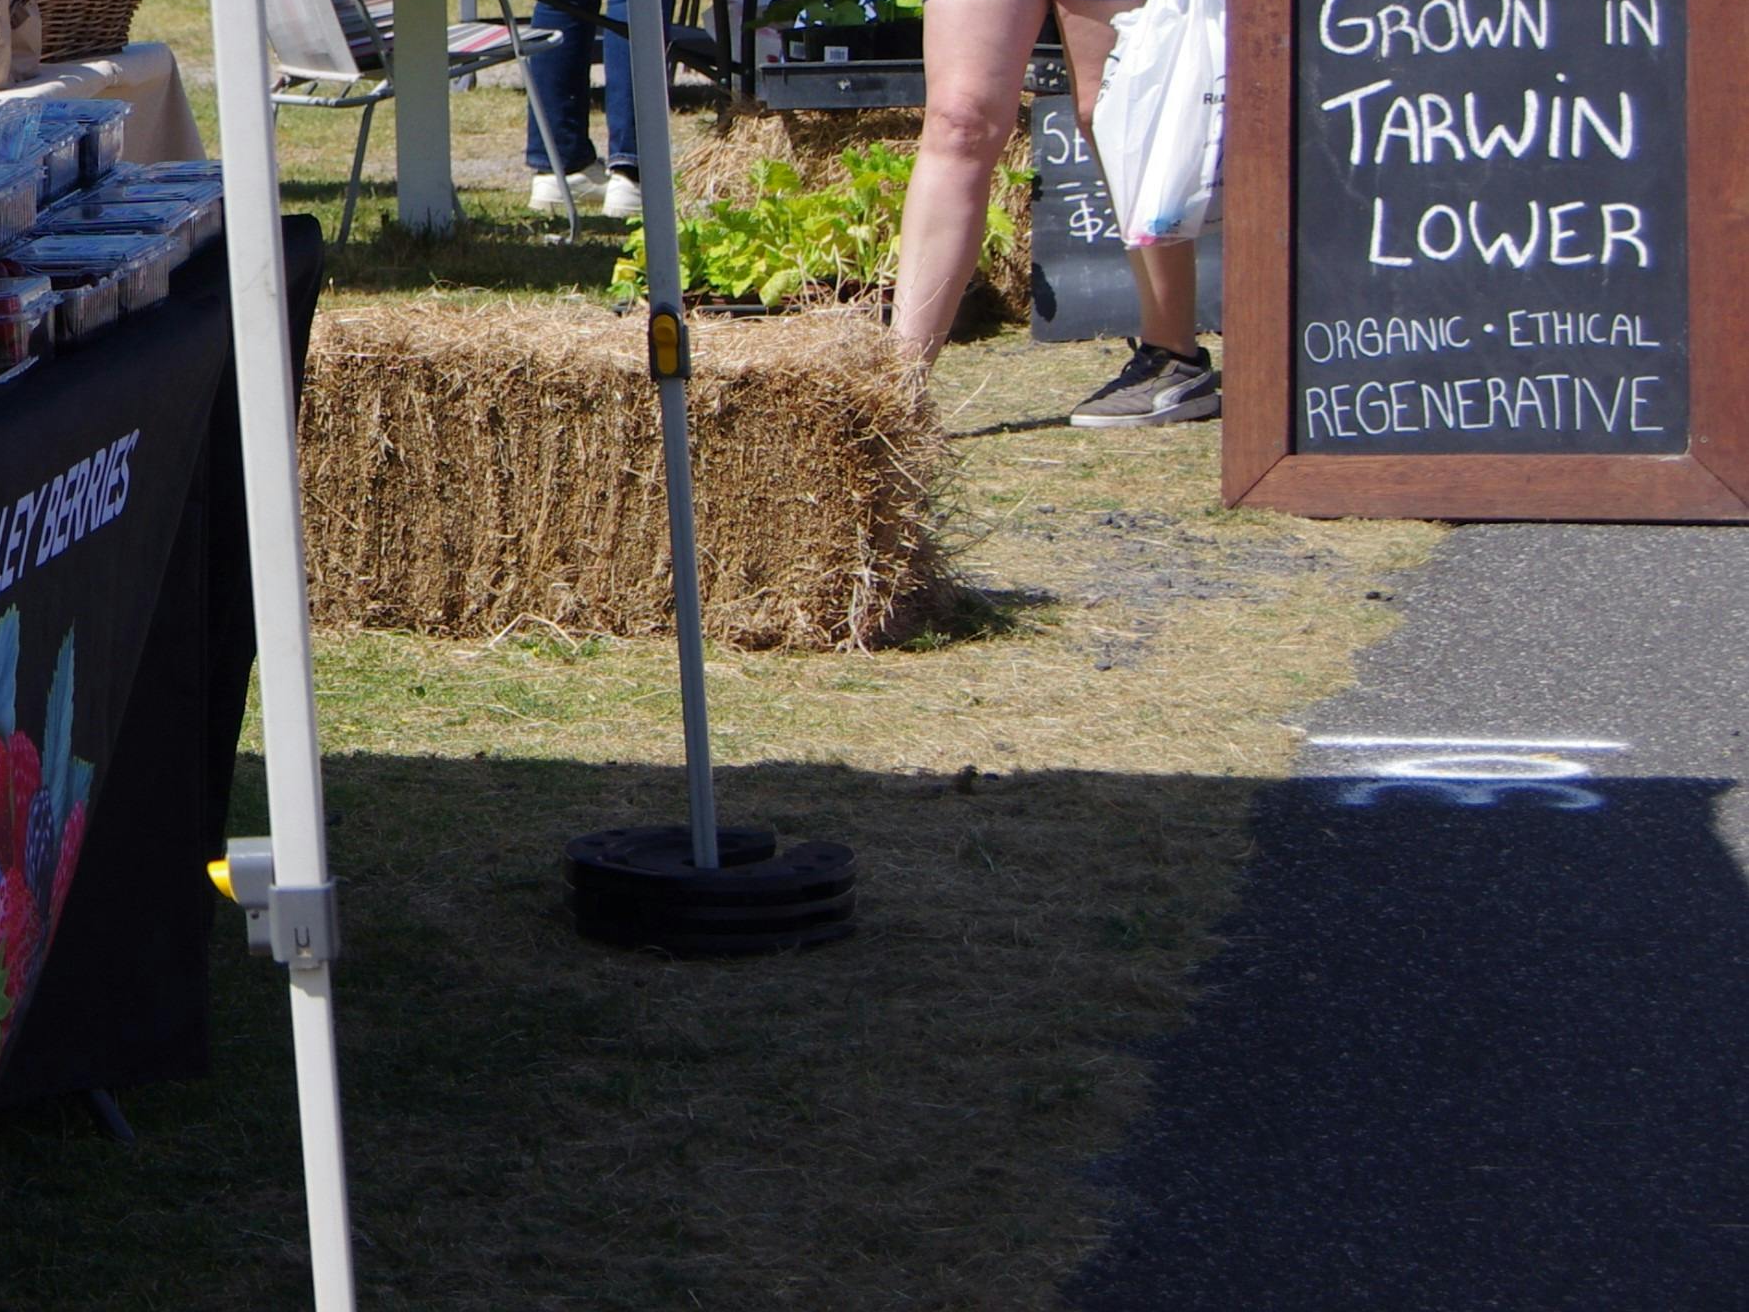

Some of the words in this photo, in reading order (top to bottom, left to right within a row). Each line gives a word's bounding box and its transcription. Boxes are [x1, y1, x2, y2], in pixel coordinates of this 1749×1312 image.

[1368, 196, 1648, 269] LOWER
[1304, 316, 1471, 364] ORGANIC
[1507, 310, 1661, 348] ETHICAL
[1305, 374, 1665, 438] REGENERATIVE
[35, 428, 141, 567] BERRIES
